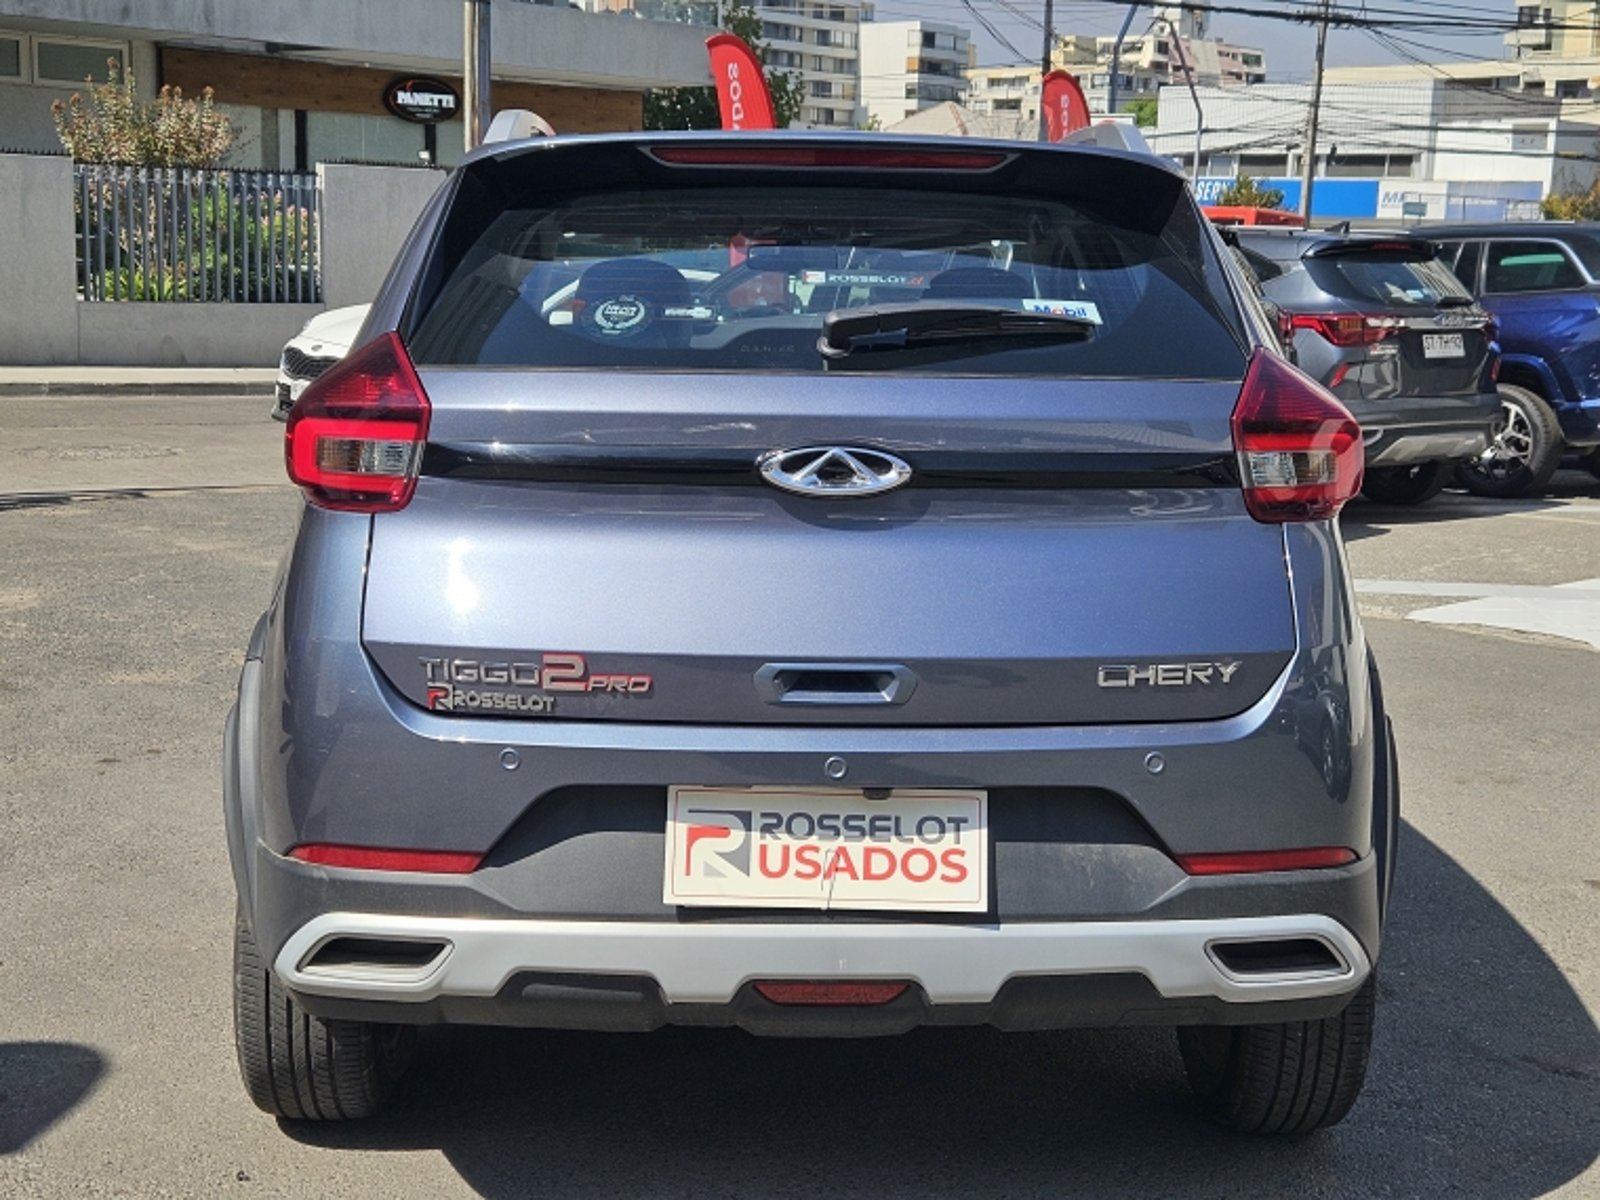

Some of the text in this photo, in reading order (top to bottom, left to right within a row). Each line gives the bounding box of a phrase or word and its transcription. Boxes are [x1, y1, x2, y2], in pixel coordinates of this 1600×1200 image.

[418, 652, 653, 692] TIGGO 2 PRO
[1097, 661, 1243, 687] CHERY
[453, 690, 555, 712] ROSSELOT
[759, 811, 969, 845] ROSSELOT
[758, 843, 969, 883] USADOS
